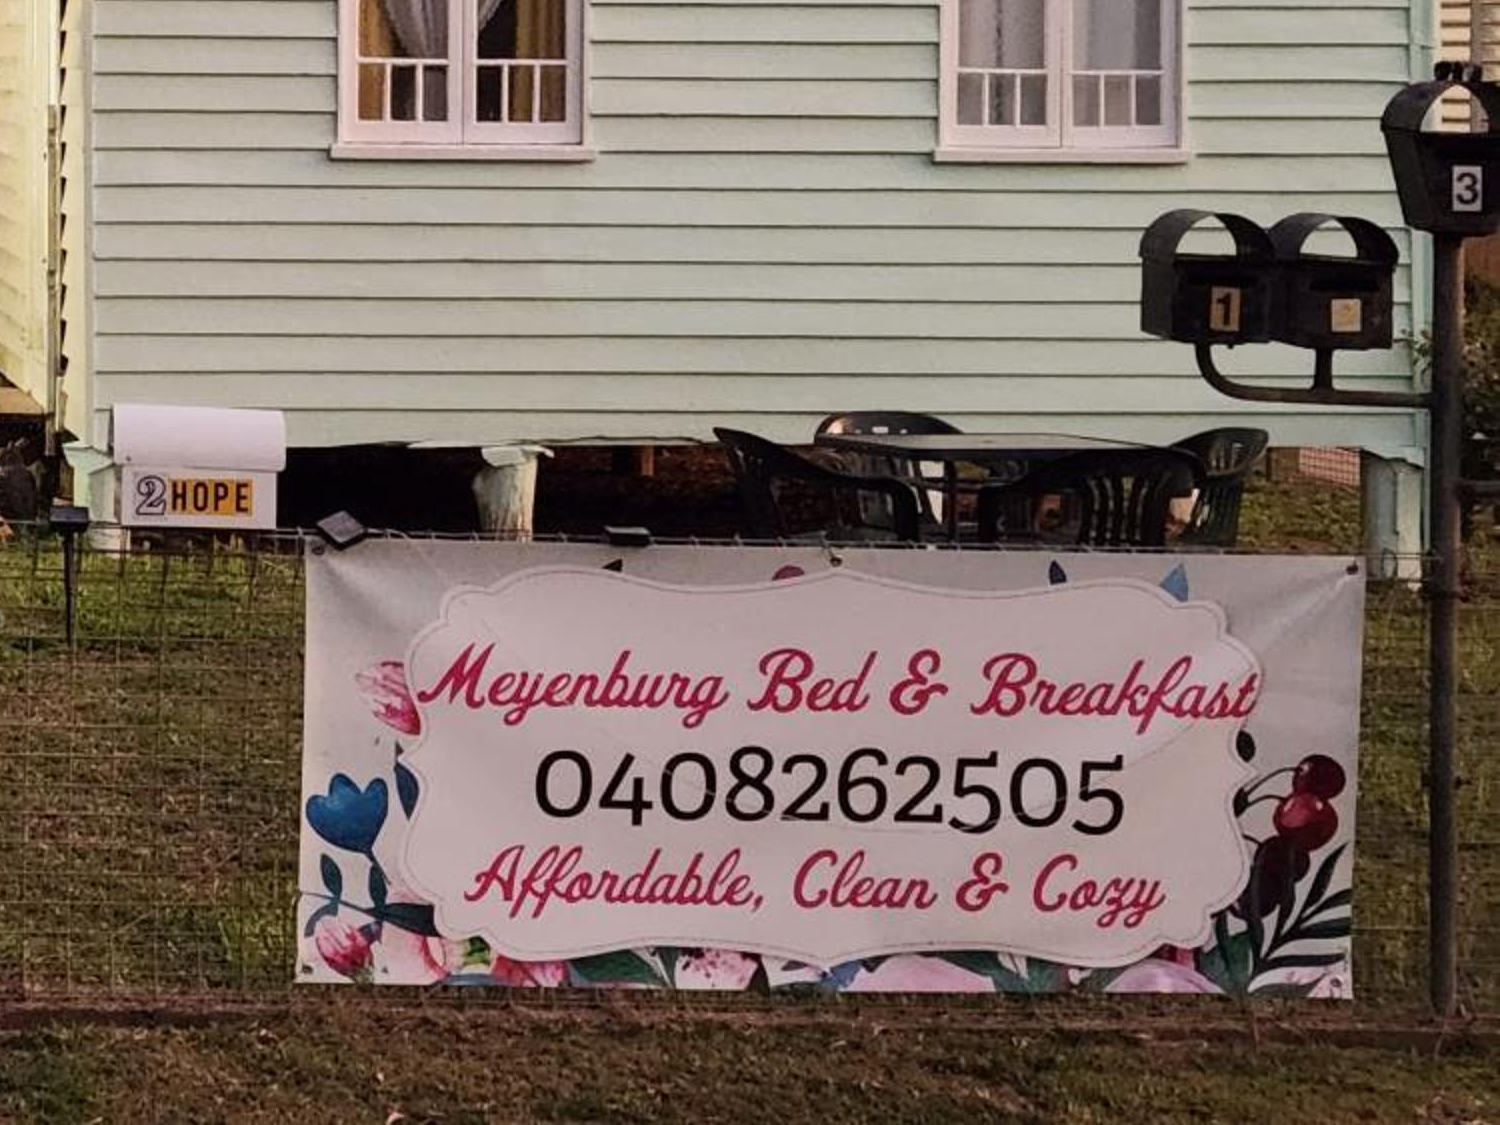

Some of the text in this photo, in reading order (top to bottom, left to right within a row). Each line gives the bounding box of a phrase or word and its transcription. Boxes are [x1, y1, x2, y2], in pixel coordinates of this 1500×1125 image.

[1455, 172, 1479, 205] 3
[1215, 292, 1232, 326] 1
[136, 475, 249, 516] 2 HOPE
[418, 643, 1259, 734] Meyenburg Bed & Breakfast
[535, 746, 1126, 835] 0408262505
[464, 846, 1165, 928] Affordable, Clean & Cozy
